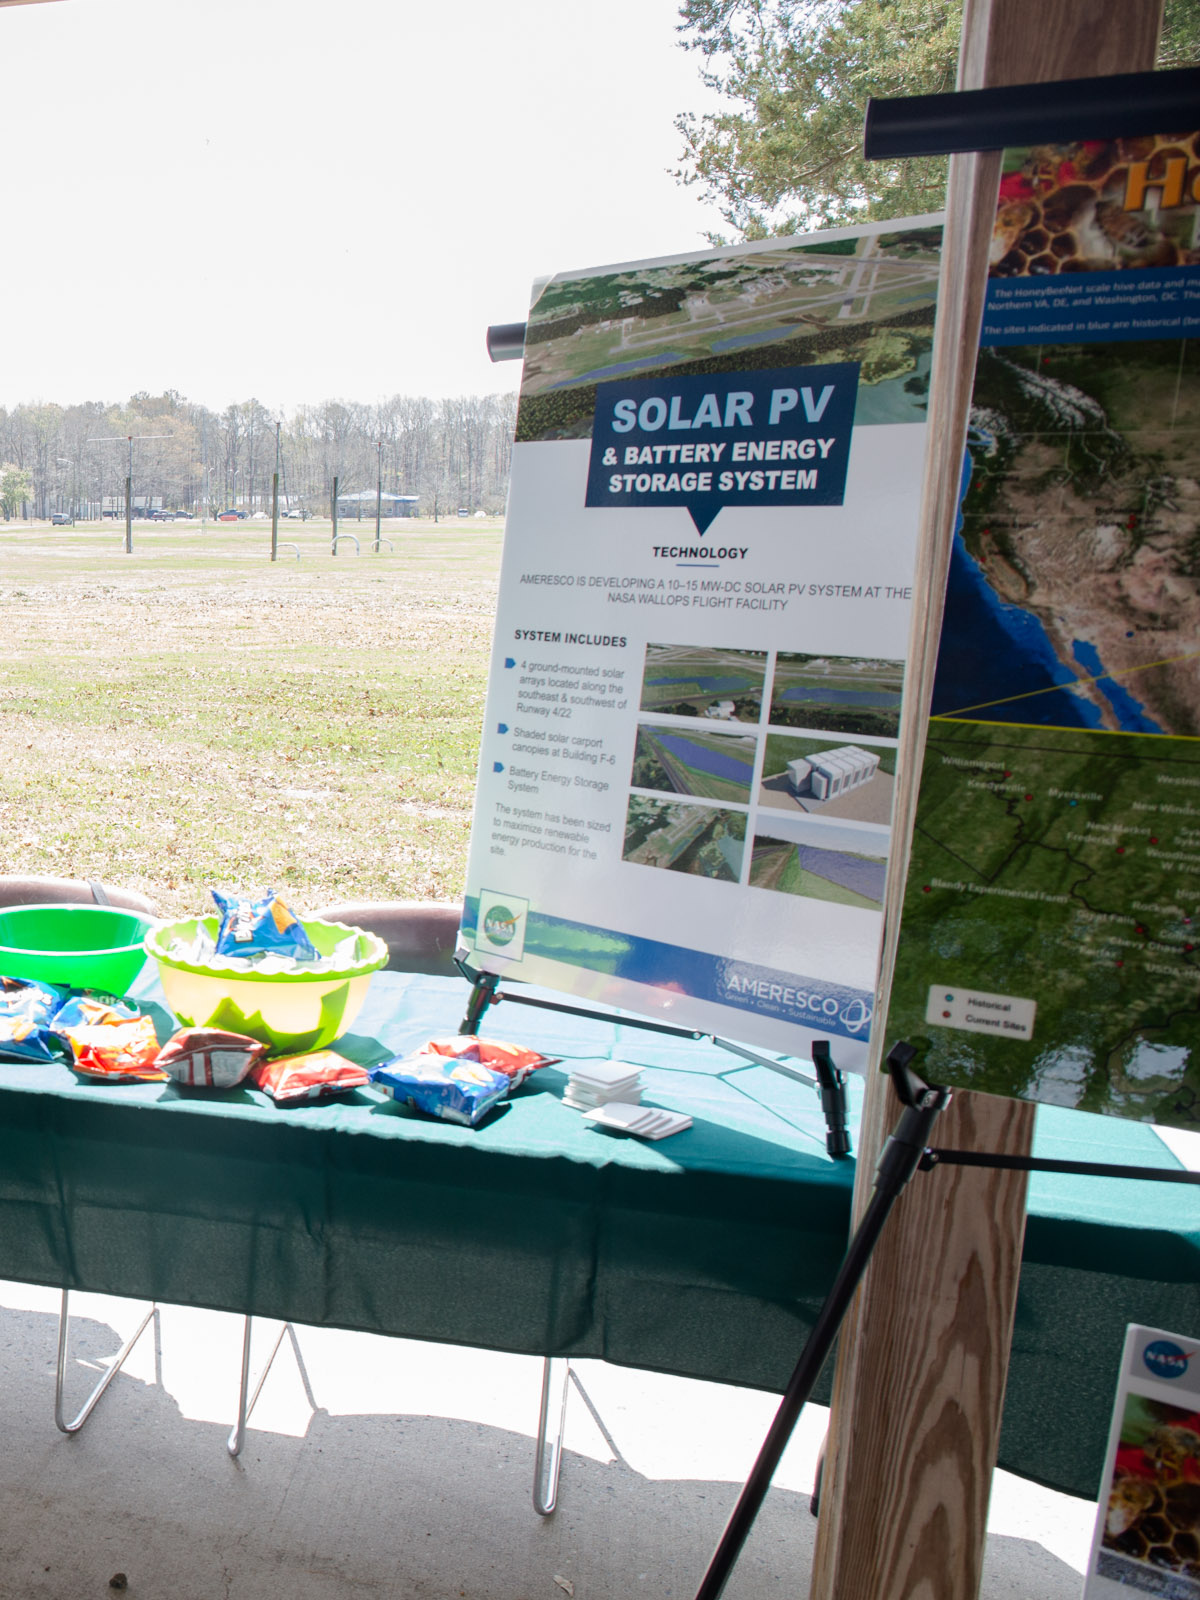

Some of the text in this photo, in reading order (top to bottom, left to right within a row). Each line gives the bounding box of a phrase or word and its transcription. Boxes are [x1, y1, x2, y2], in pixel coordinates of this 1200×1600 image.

[1086, 283, 1111, 294] scale
[1138, 280, 1161, 290] data
[1165, 278, 1185, 288] and
[987, 298, 1032, 311] Northern
[1072, 296, 1092, 307] and
[1028, 322, 1073, 333] indicated
[1087, 320, 1109, 331] blue
[1132, 317, 1181, 329] historical
[611, 385, 835, 433] SOLAR PV
[602, 438, 836, 466] & BATTERY ENERGY
[609, 469, 818, 493] STORAGE SYSTEM
[653, 546, 749, 559] TECHNOLOGY
[520, 574, 574, 586] AMERESCO
[576, 576, 586, 586] IS
[588, 576, 655, 589] DEVELOPING
[657, 579, 665, 589] A
[701, 581, 742, 593] MW-DC
[744, 581, 785, 594] SOLAR
[788, 583, 806, 595] PV
[808, 584, 863, 598] SYSTEM
[864, 586, 882, 598] AT
[885, 587, 912, 599] THE
[608, 592, 788, 610] NASA WALLOPS FLIGHT FACILITY
[514, 629, 627, 648] SYSTEM INCLUDES
[521, 661, 625, 679] 4 ground-mounted solar
[520, 676, 623, 695] arrays located along the
[518, 690, 627, 709] southeast & southwest of
[516, 702, 572, 718] Runway 4/22
[513, 727, 603, 749] Shaded solar carport
[512, 743, 616, 765] canopies at Building F-6
[508, 780, 539, 793] System
[509, 766, 609, 792] Battery Energy Storage
[496, 802, 612, 833] The system has been sized
[493, 817, 590, 843] to maximize renewable
[490, 846, 506, 856] site.
[491, 832, 597, 860] energy production for the
[968, 882, 1039, 900] Experimental
[487, 918, 513, 933] NASA
[727, 975, 839, 1015] AMERESCO
[968, 998, 1011, 1012] Historical
[965, 1014, 1026, 1032] Current Sites
[1146, 1350, 1185, 1368] NASA
